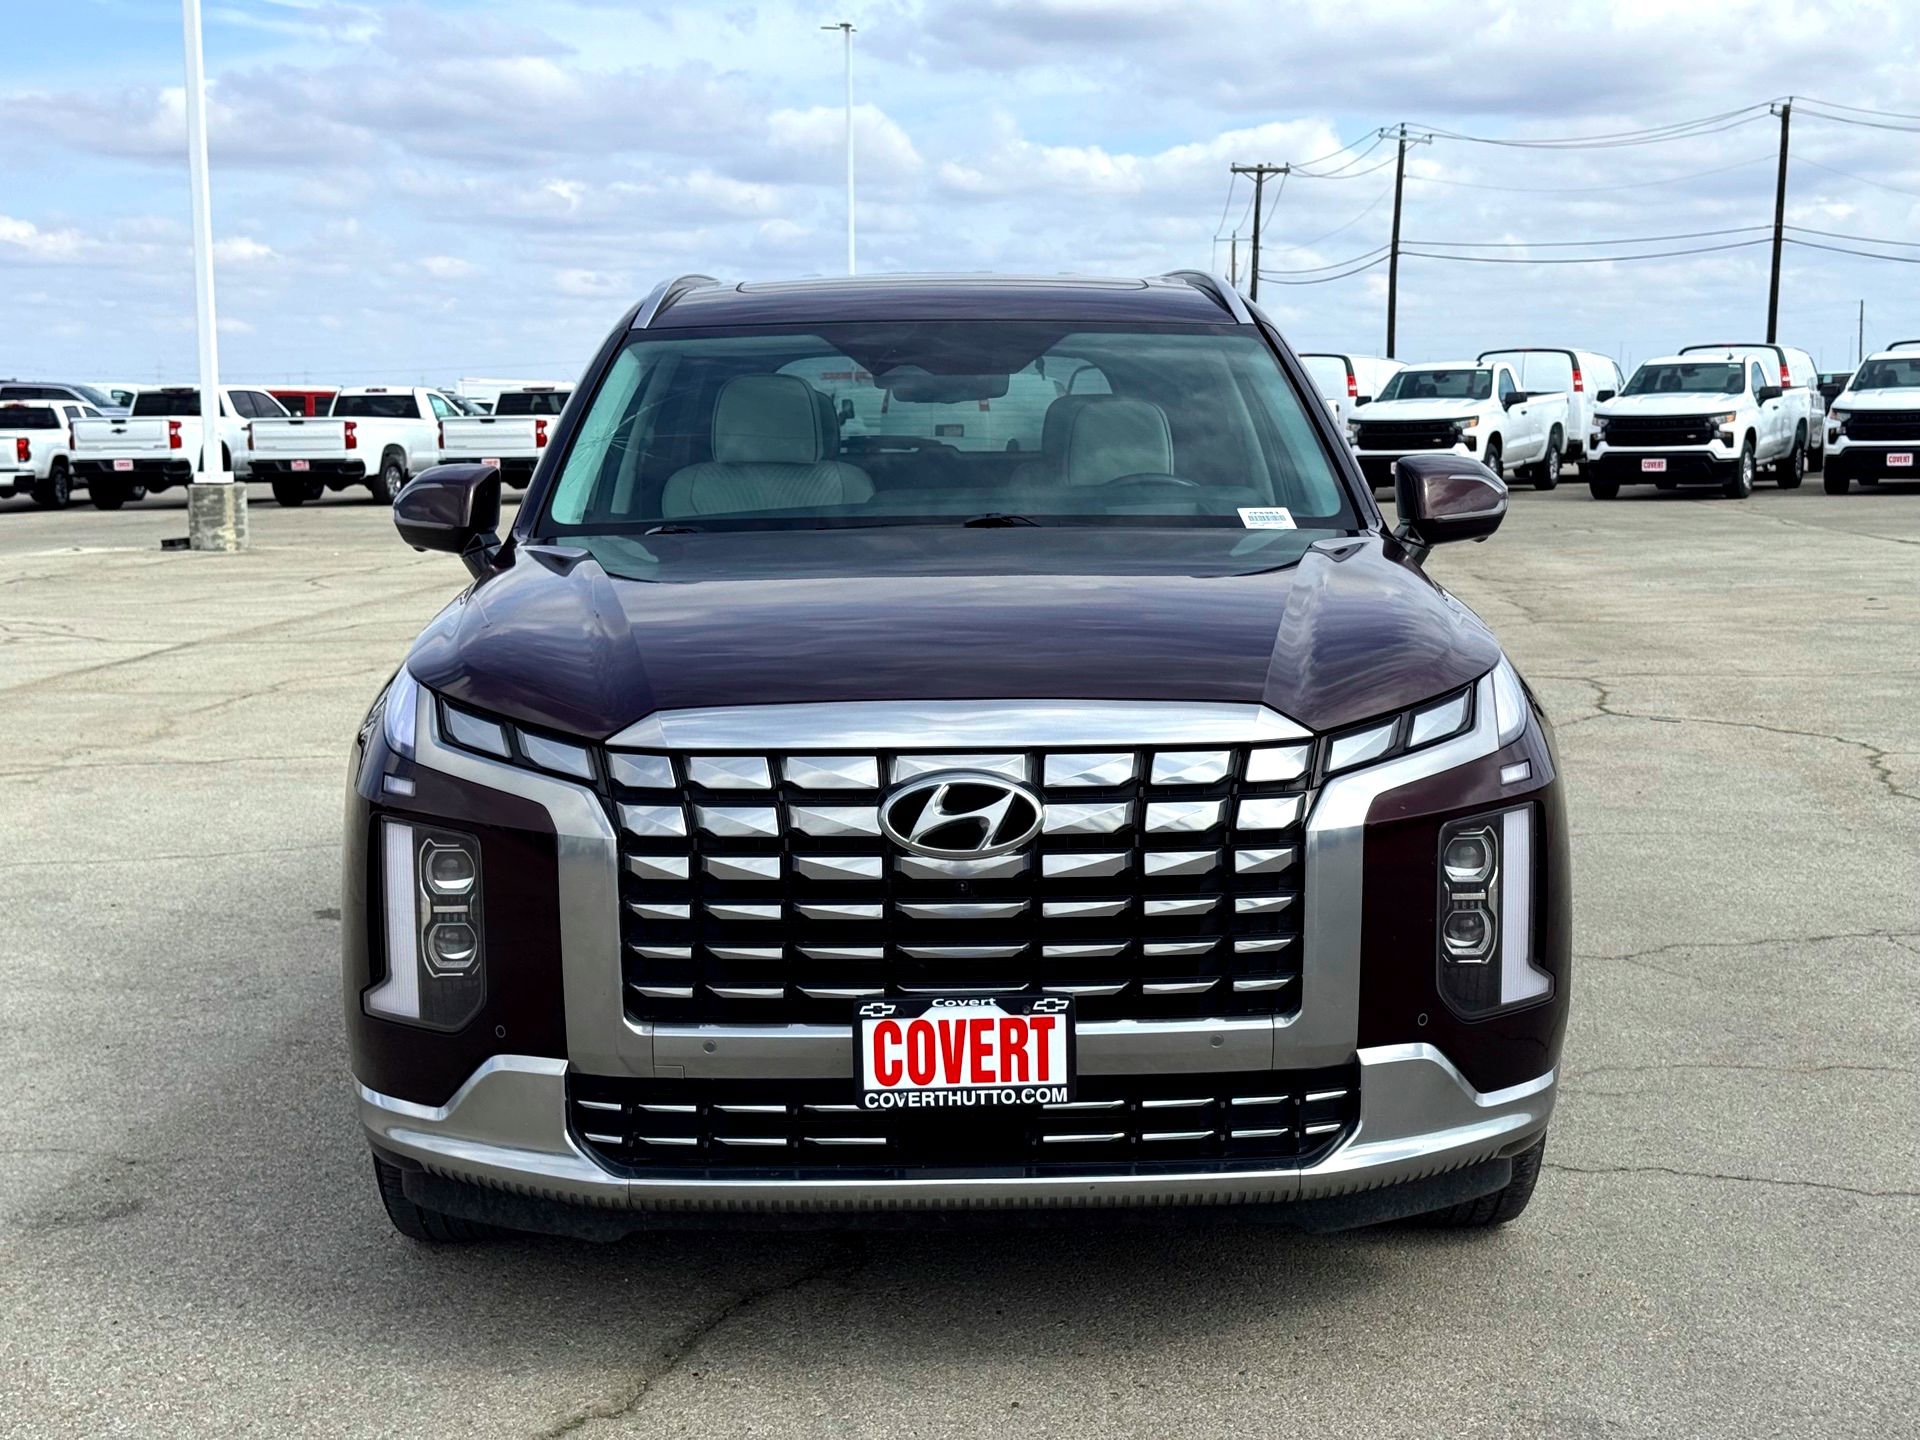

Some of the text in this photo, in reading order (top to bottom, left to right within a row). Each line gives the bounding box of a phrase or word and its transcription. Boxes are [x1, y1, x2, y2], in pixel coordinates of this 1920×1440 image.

[931, 998, 996, 1007] Covert
[873, 1016, 1056, 1087] COVERT
[864, 1087, 1068, 1109] COVERTHUTTO.COM
